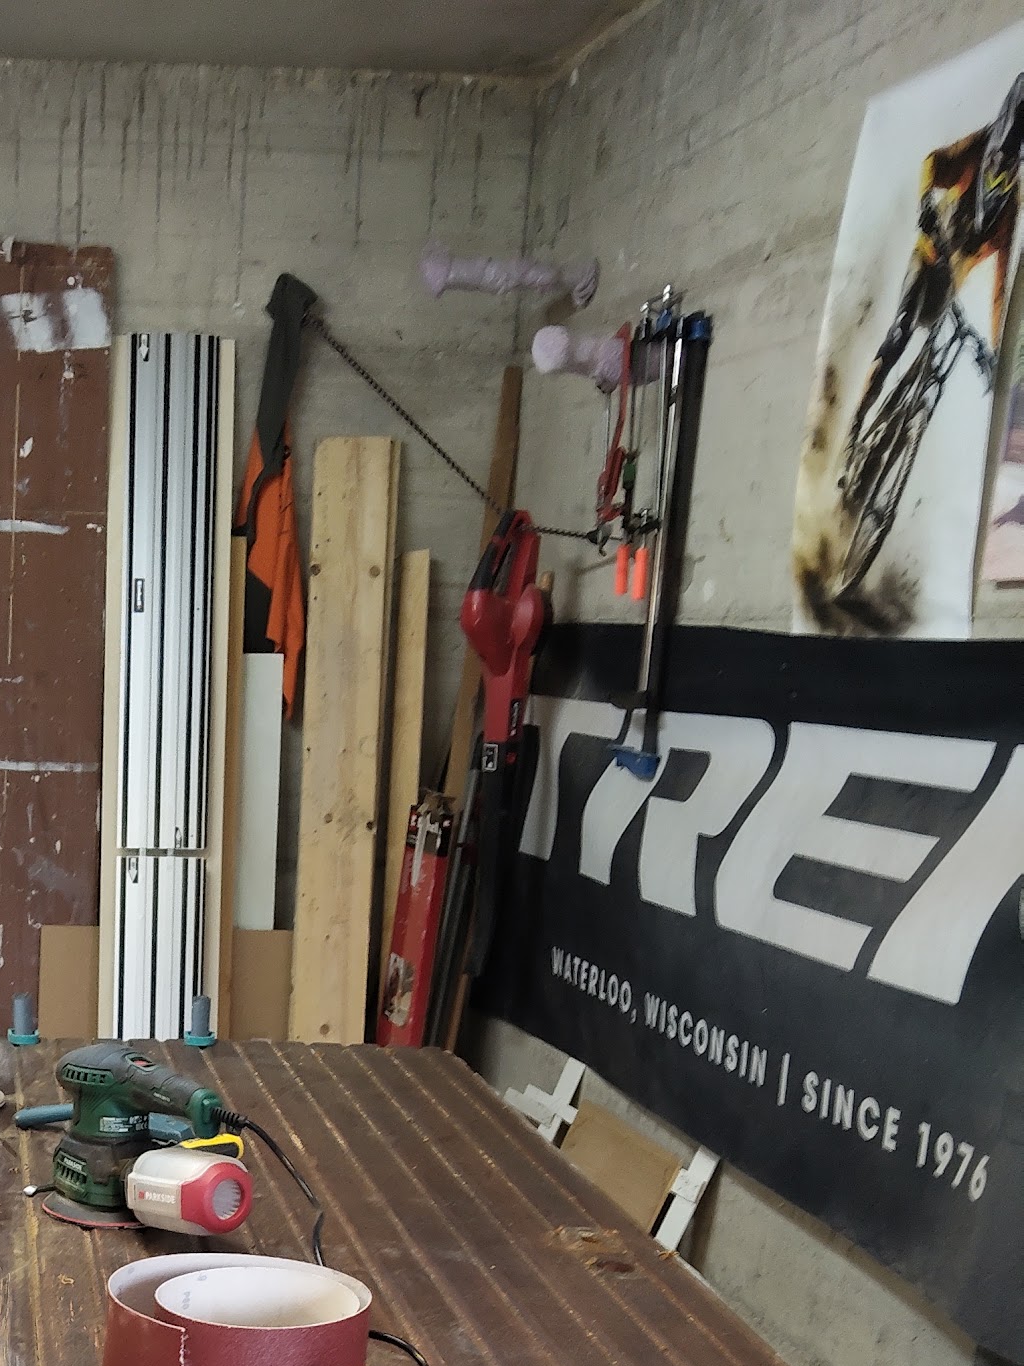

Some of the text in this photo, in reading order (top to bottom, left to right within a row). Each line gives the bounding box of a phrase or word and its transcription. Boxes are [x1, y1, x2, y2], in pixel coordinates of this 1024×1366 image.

[552, 946, 637, 1024] WATERLOO,
[645, 992, 767, 1087] WISCONSIN
[802, 1071, 901, 1152] SINCE
[916, 1121, 990, 1202] 1976
